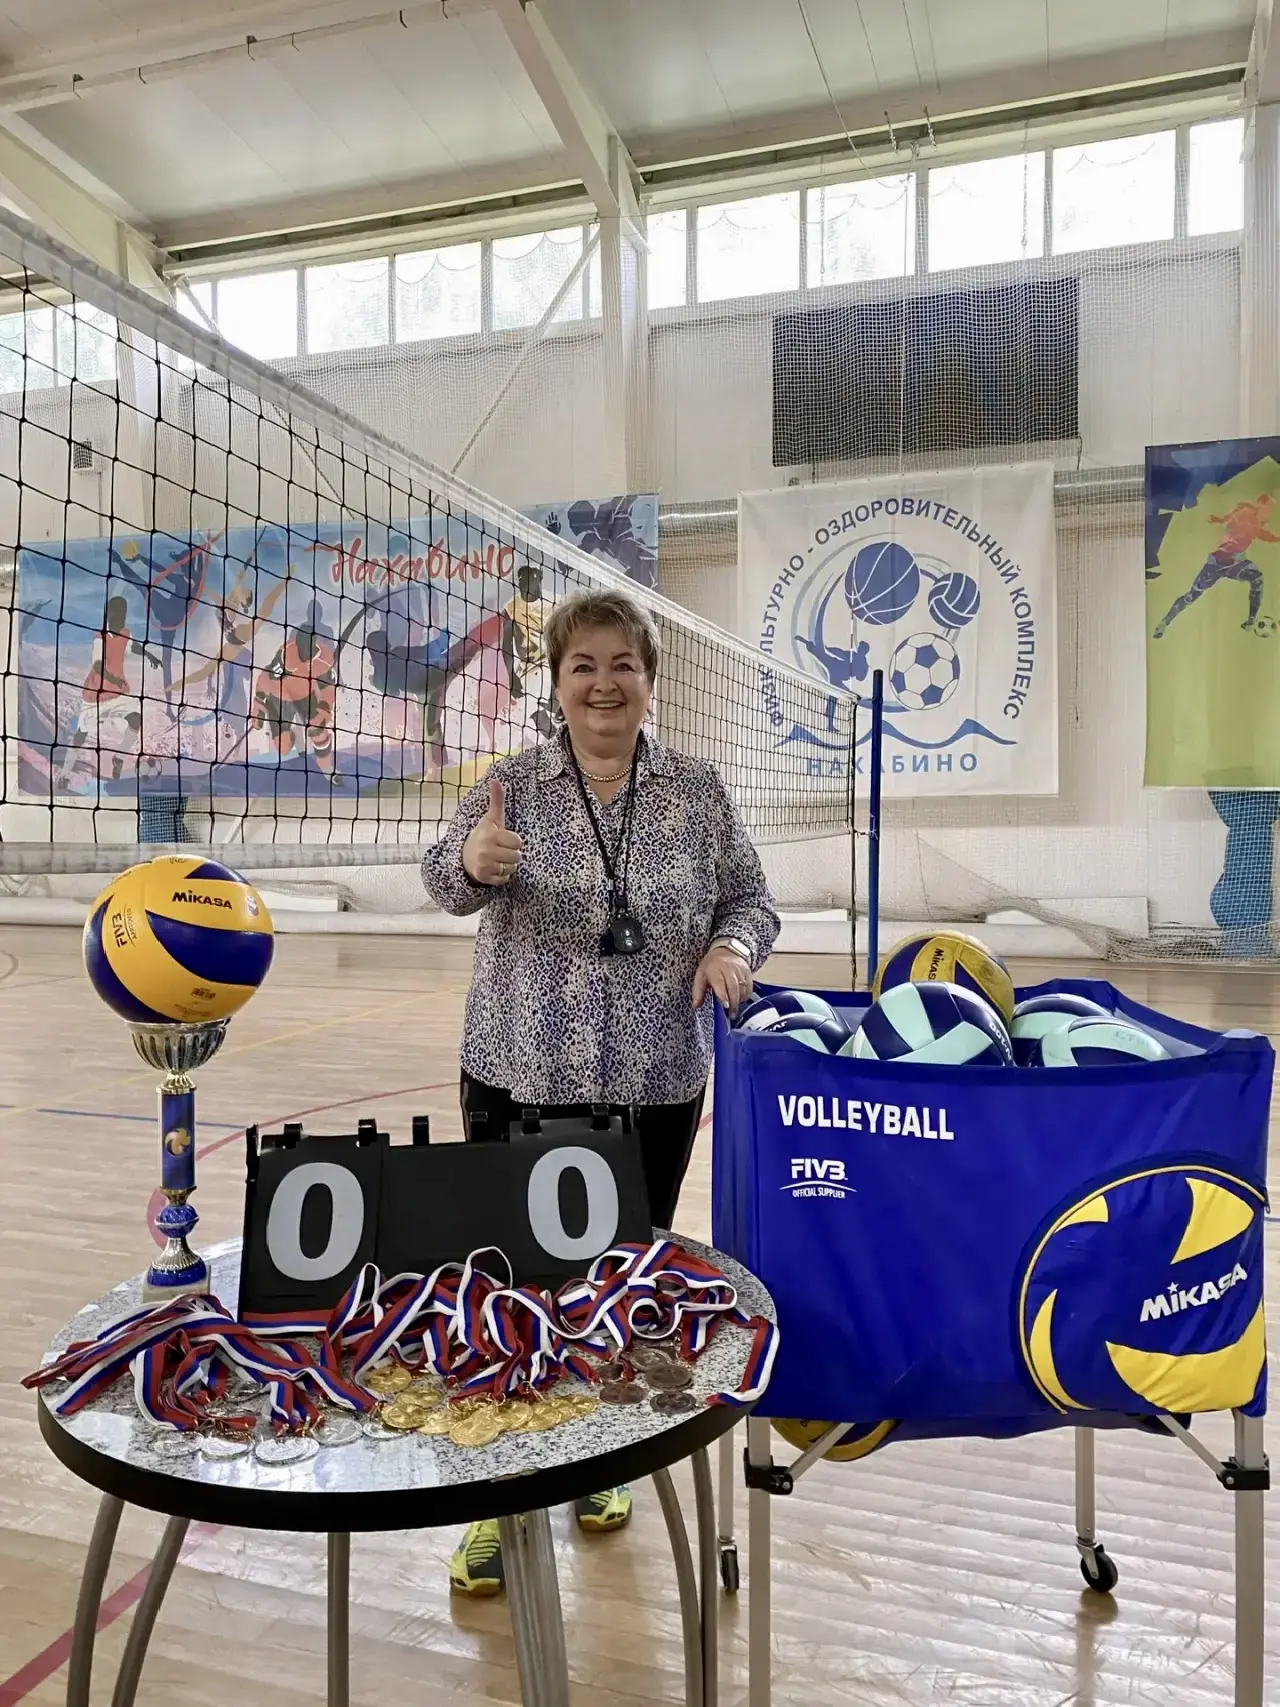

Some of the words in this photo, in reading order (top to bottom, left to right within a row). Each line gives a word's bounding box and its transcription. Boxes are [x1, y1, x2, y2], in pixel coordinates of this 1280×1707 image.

[304, 537, 515, 587] Нахабино
[758, 554, 805, 727] ФИЗКЛЬТУРНО
[815, 498, 1021, 584] ОЗДОРОВИТЕЛЬНЫЙ
[1003, 586, 1035, 720] КОМПЛЕКС
[928, 947, 944, 980] MIKAS
[777, 1094, 955, 1140] VOLLEYBALL
[791, 1158, 846, 1181] FIVB
[792, 1187, 817, 1198] OFFICIAL
[817, 1186, 846, 1199] SUPPLIER
[266, 1161, 365, 1282] 0
[527, 1145, 620, 1261] 0
